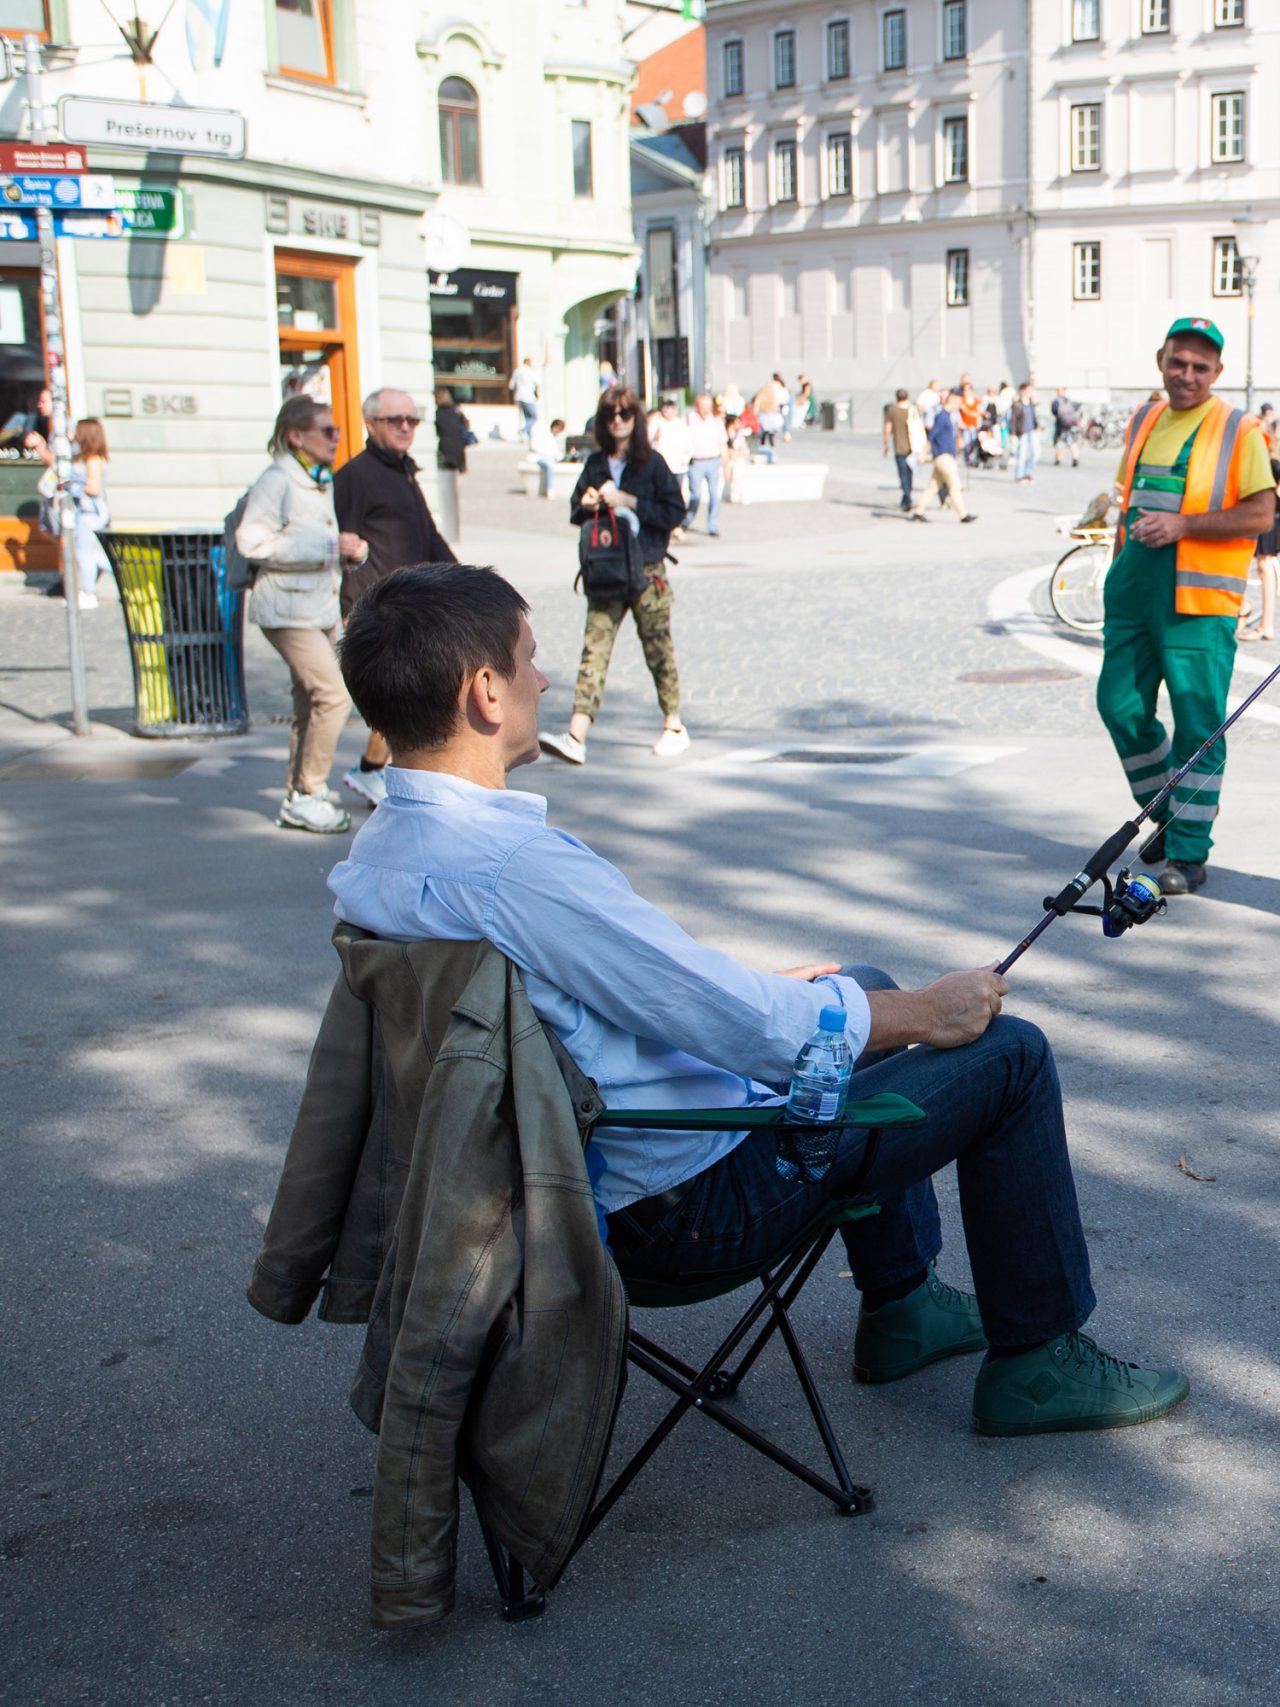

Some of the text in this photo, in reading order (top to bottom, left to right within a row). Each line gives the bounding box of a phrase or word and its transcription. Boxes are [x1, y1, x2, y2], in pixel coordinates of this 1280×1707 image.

[106, 119, 232, 147] Prešernov trg
[303, 209, 348, 240] SKB
[141, 394, 198, 415] SKB
